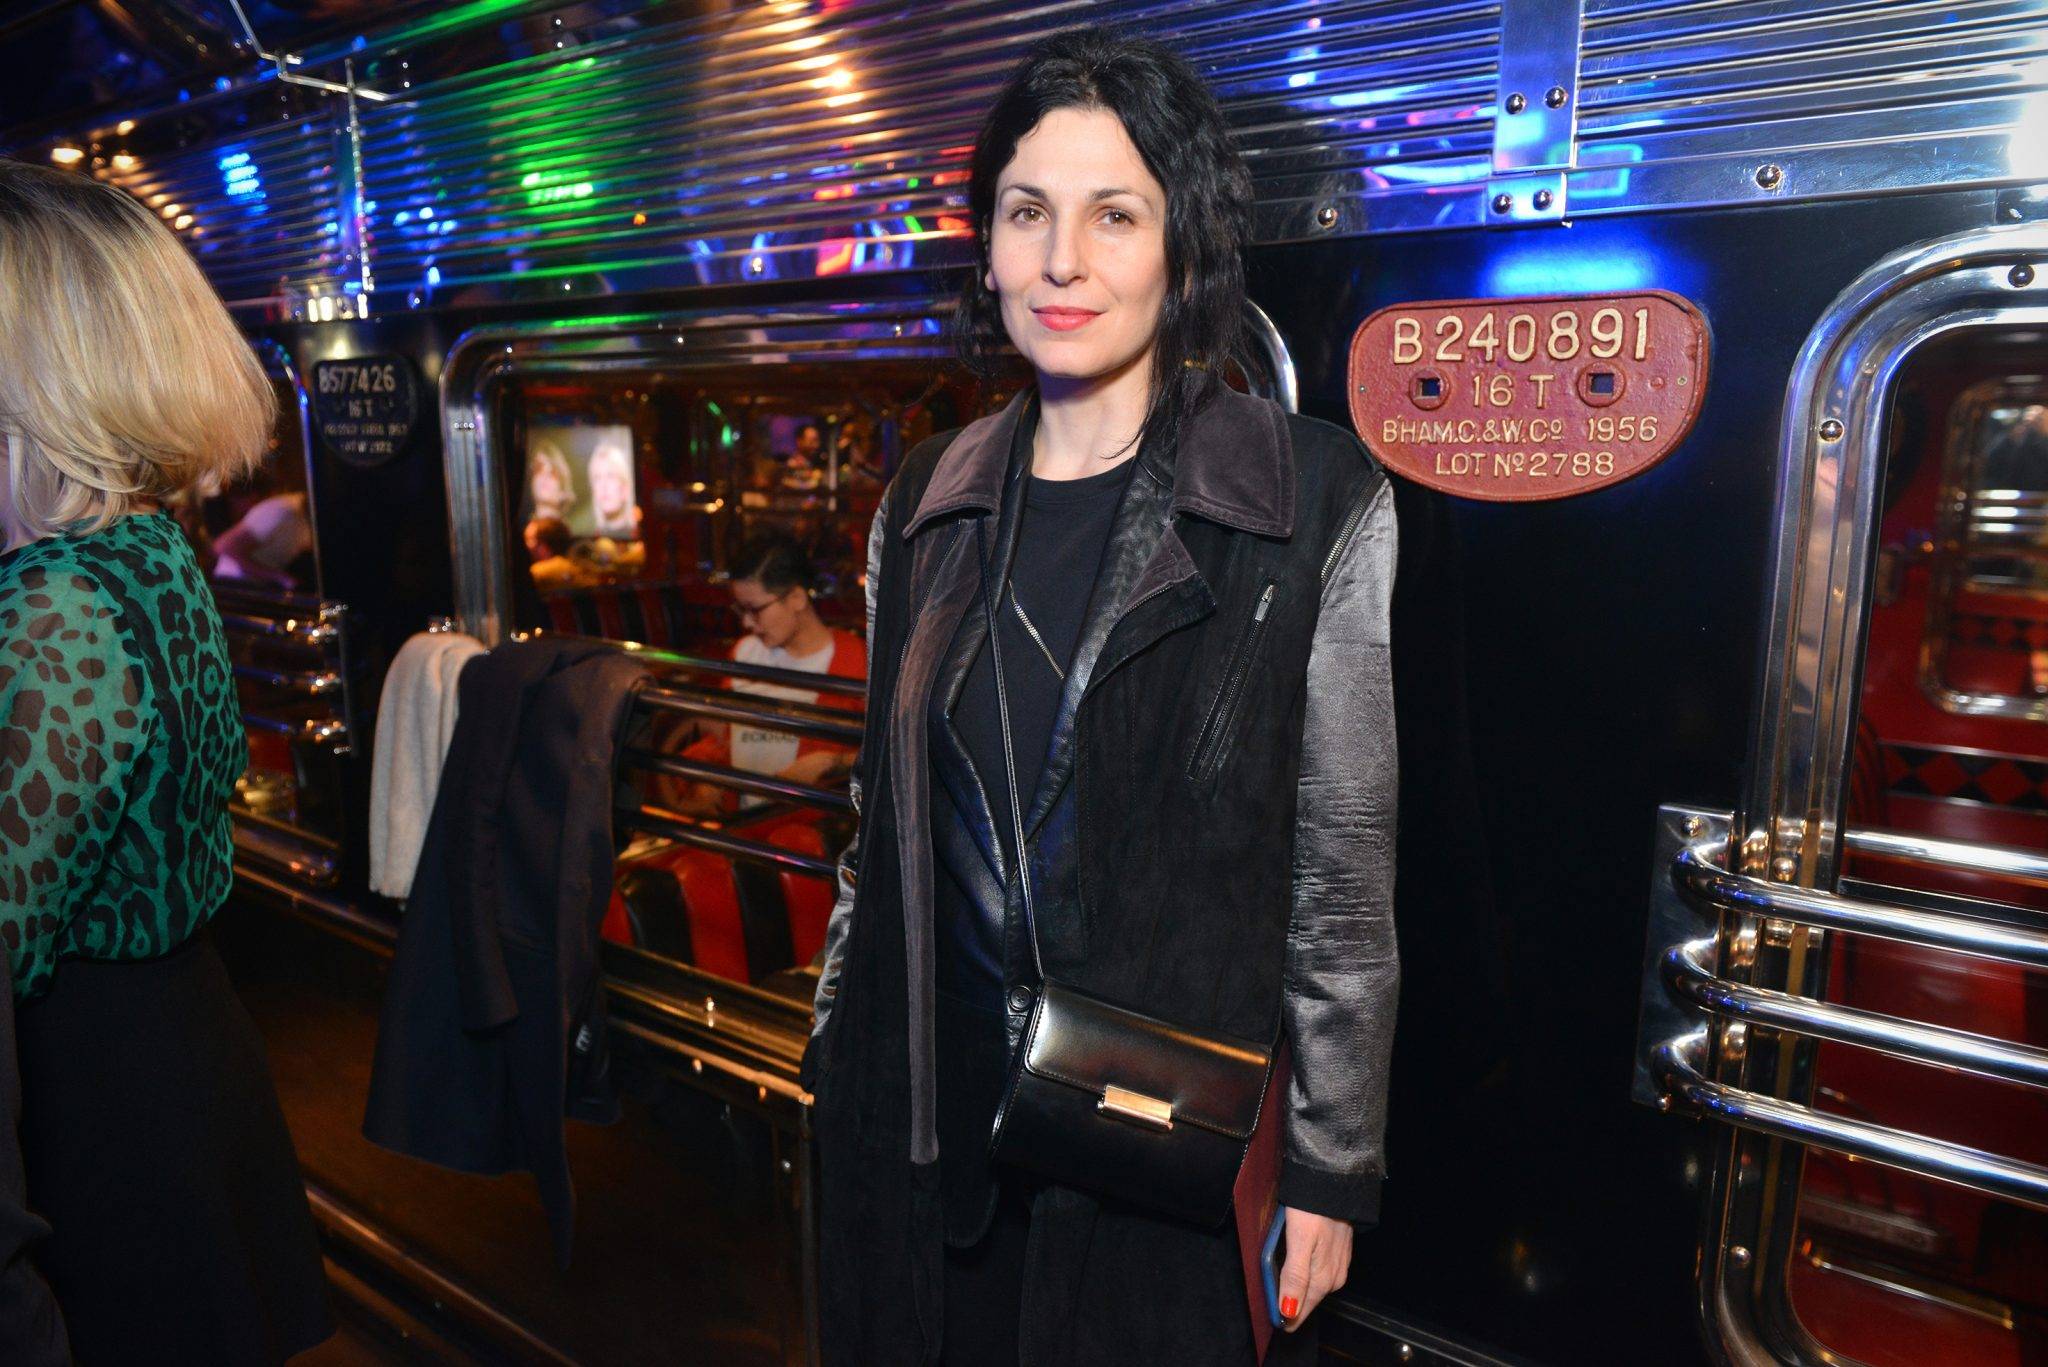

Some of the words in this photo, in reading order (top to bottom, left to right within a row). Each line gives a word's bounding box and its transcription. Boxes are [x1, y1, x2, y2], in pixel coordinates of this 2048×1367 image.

[1394, 309, 1648, 364] B240891
[1473, 374, 1513, 407] 16
[1529, 374, 1555, 408] T
[1588, 416, 1658, 442] 1956
[1436, 452, 1486, 476] LOT
